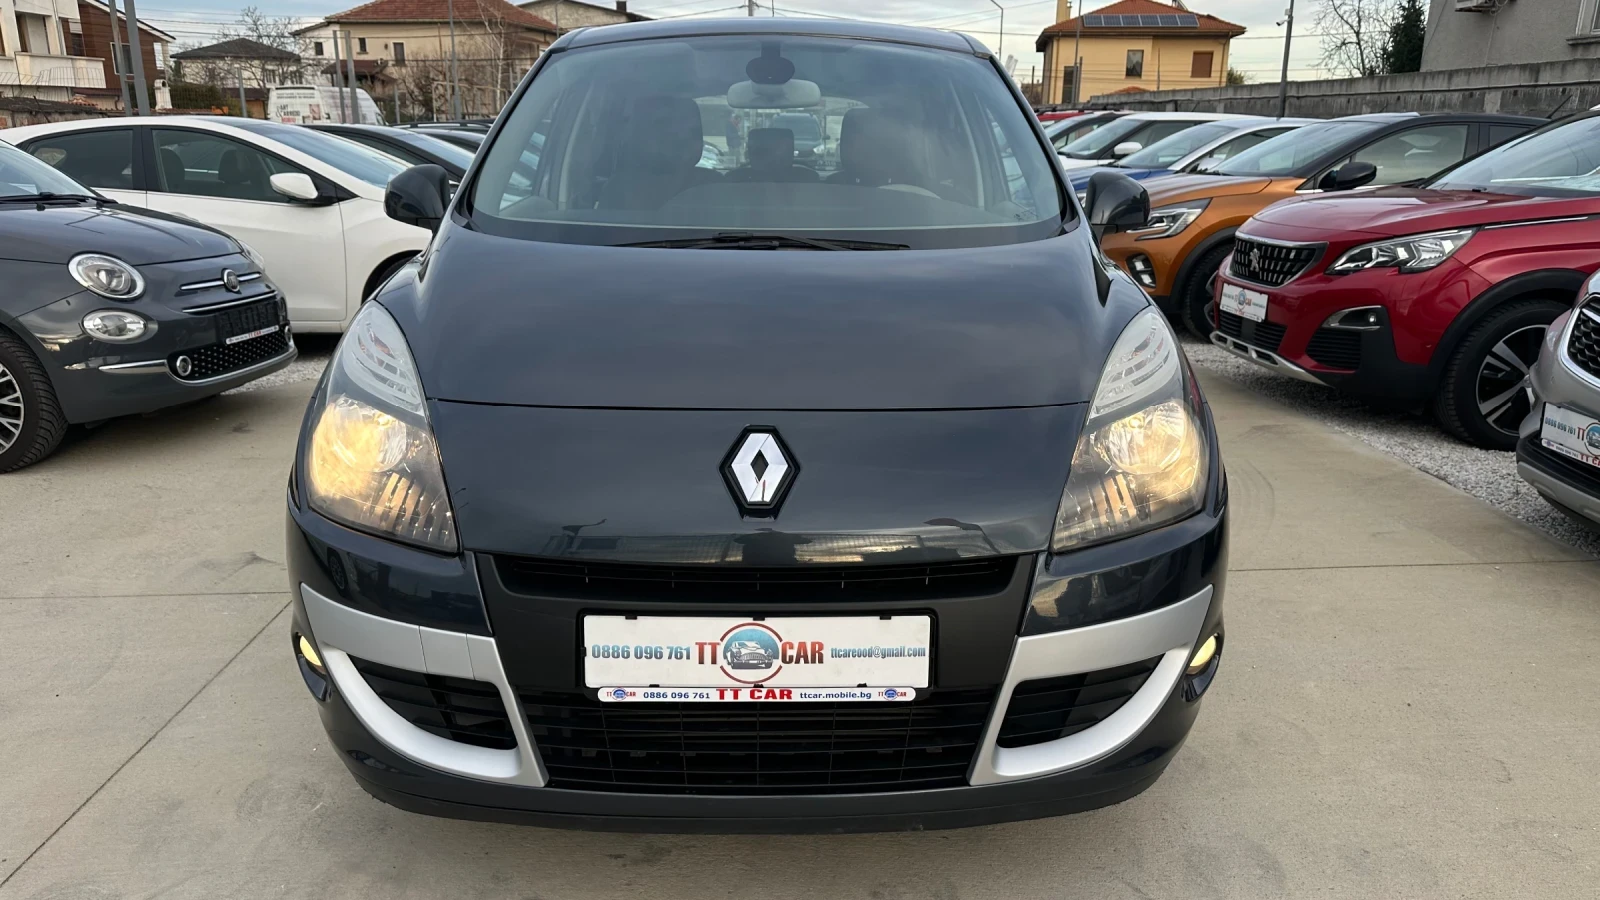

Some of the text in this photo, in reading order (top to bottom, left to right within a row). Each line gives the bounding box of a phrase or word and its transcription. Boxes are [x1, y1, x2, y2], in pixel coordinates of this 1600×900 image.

[1577, 427, 1586, 441] TT
[1580, 453, 1589, 462] TT
[591, 641, 926, 665] 0886 096 761 TT CAR ttcareood@gmail.com
[716, 688, 742, 700] TT
[749, 688, 793, 700] CAR
[800, 691, 872, 700] ttcar.mobile.bg
